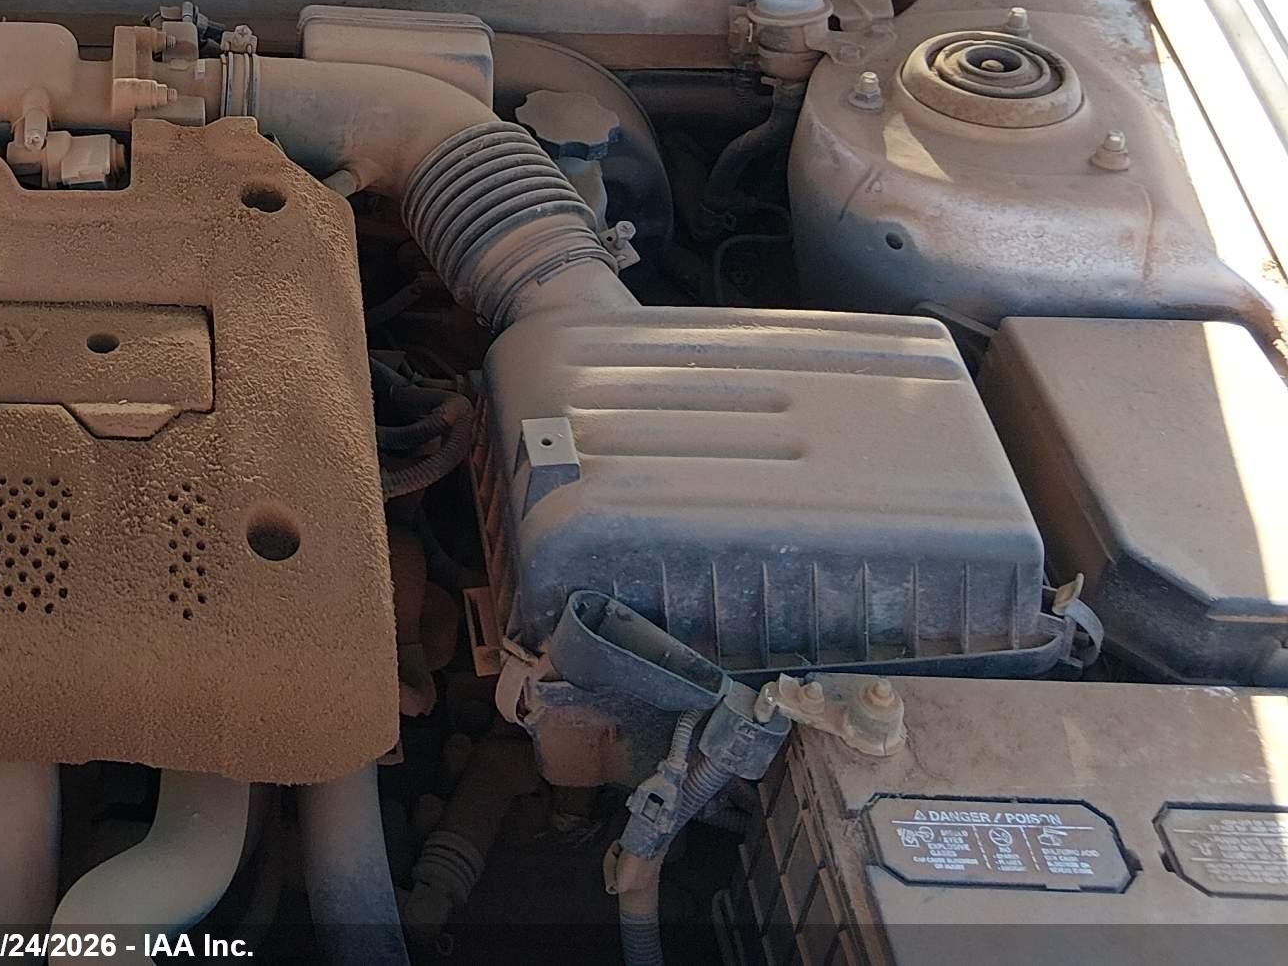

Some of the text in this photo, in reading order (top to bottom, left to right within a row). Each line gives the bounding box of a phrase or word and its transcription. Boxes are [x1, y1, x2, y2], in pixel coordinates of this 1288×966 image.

[928, 810, 1064, 826] DANGER / POISON
